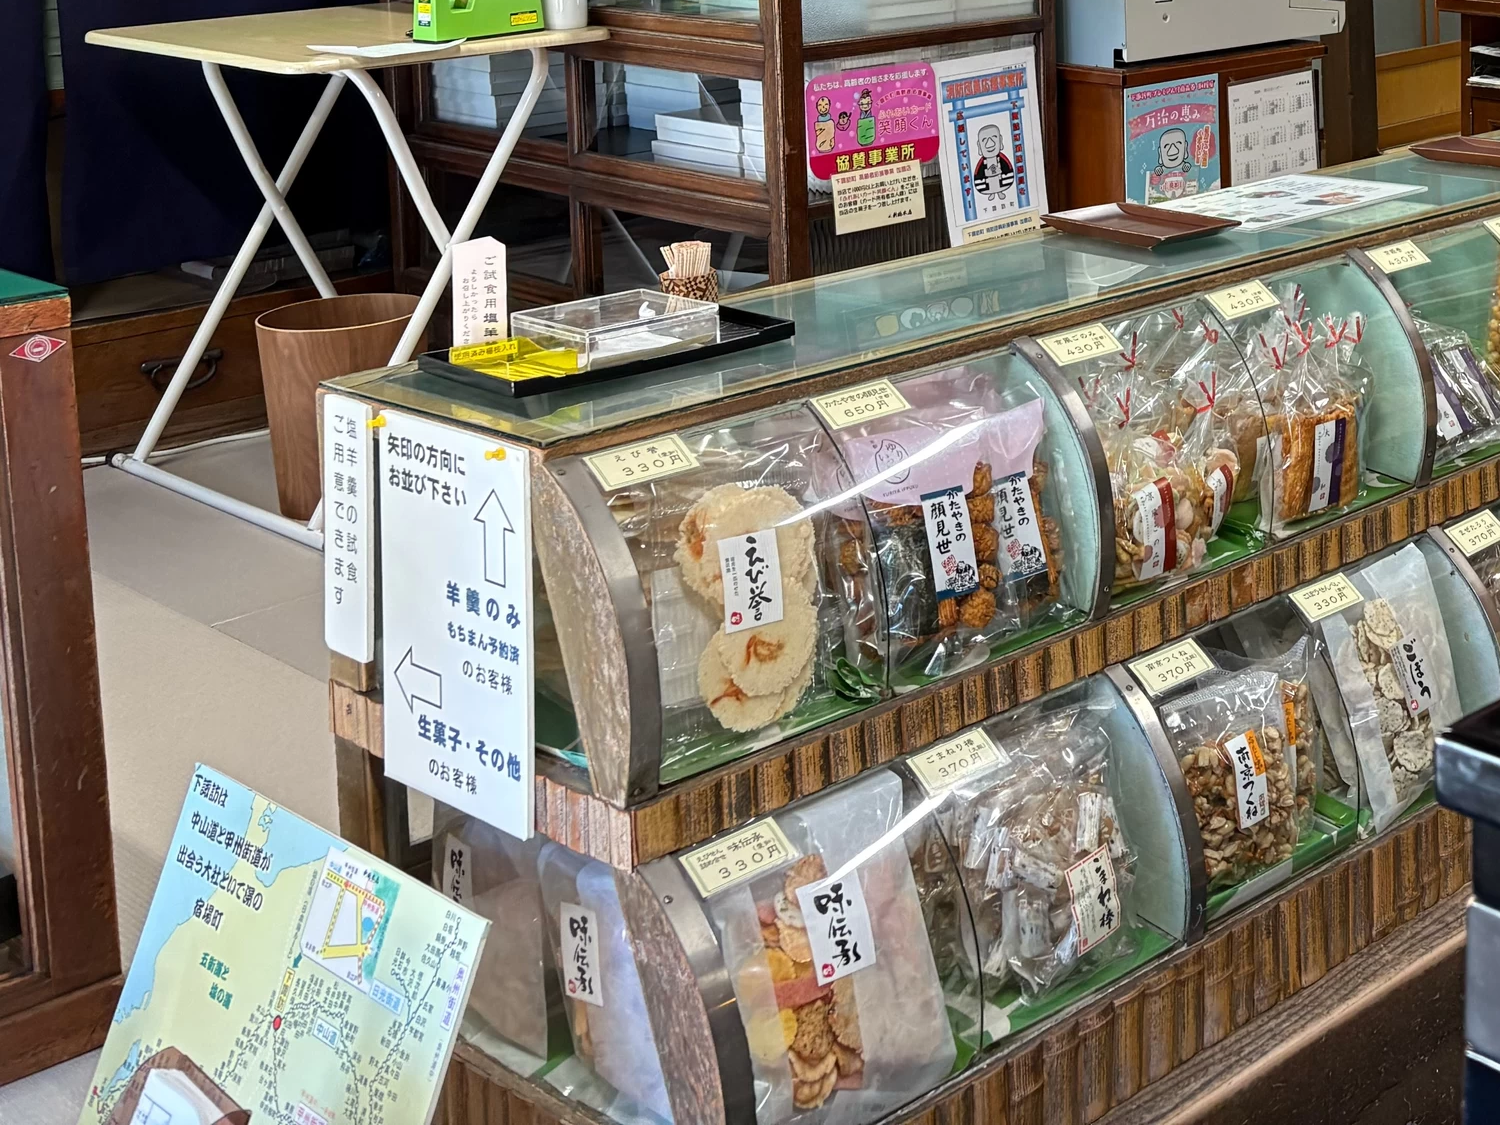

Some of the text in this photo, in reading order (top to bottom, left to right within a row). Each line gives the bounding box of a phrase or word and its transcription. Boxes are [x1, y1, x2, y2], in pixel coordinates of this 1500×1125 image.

[878, 117, 934, 136] 笑顔くん
[1145, 105, 1200, 128] 万治の恵み
[836, 143, 915, 173] 協賛事業所
[1388, 254, 1417, 267] 430円
[462, 277, 470, 344] お召し上がりくださ
[471, 268, 479, 322] よろしかったら
[1230, 296, 1265, 311] 430円
[1066, 340, 1105, 356] 430円
[843, 399, 889, 418] 650円
[387, 432, 467, 477] 矢印の方向に
[622, 455, 684, 477] 330円
[346, 415, 359, 584] 塩羊羹の試食
[388, 464, 468, 508] お並び下さい
[1008, 475, 1030, 526] かたやきの
[333, 413, 346, 605] ご用意できます
[930, 502, 952, 554] 顔見世
[946, 490, 967, 542] かたやきの
[1468, 528, 1497, 547] 370円
[745, 536, 773, 621] えび誉
[1313, 591, 1348, 611] 330円
[447, 620, 520, 666] もちまん予約済
[462, 658, 514, 696] のお客様
[1158, 661, 1196, 683] 370円
[417, 711, 523, 783] 生菓子・その他
[926, 737, 974, 764] ごまねり棒
[938, 752, 982, 778] 370円
[193, 773, 229, 809] 下諏訪は
[429, 756, 479, 797] のお客様
[190, 811, 274, 873] 中山道と甲州街道が
[176, 844, 264, 913] 出会う大社といで湯の
[718, 844, 781, 880] 330円
[192, 897, 224, 932] 宿場町
[814, 881, 862, 969] 味伝承
